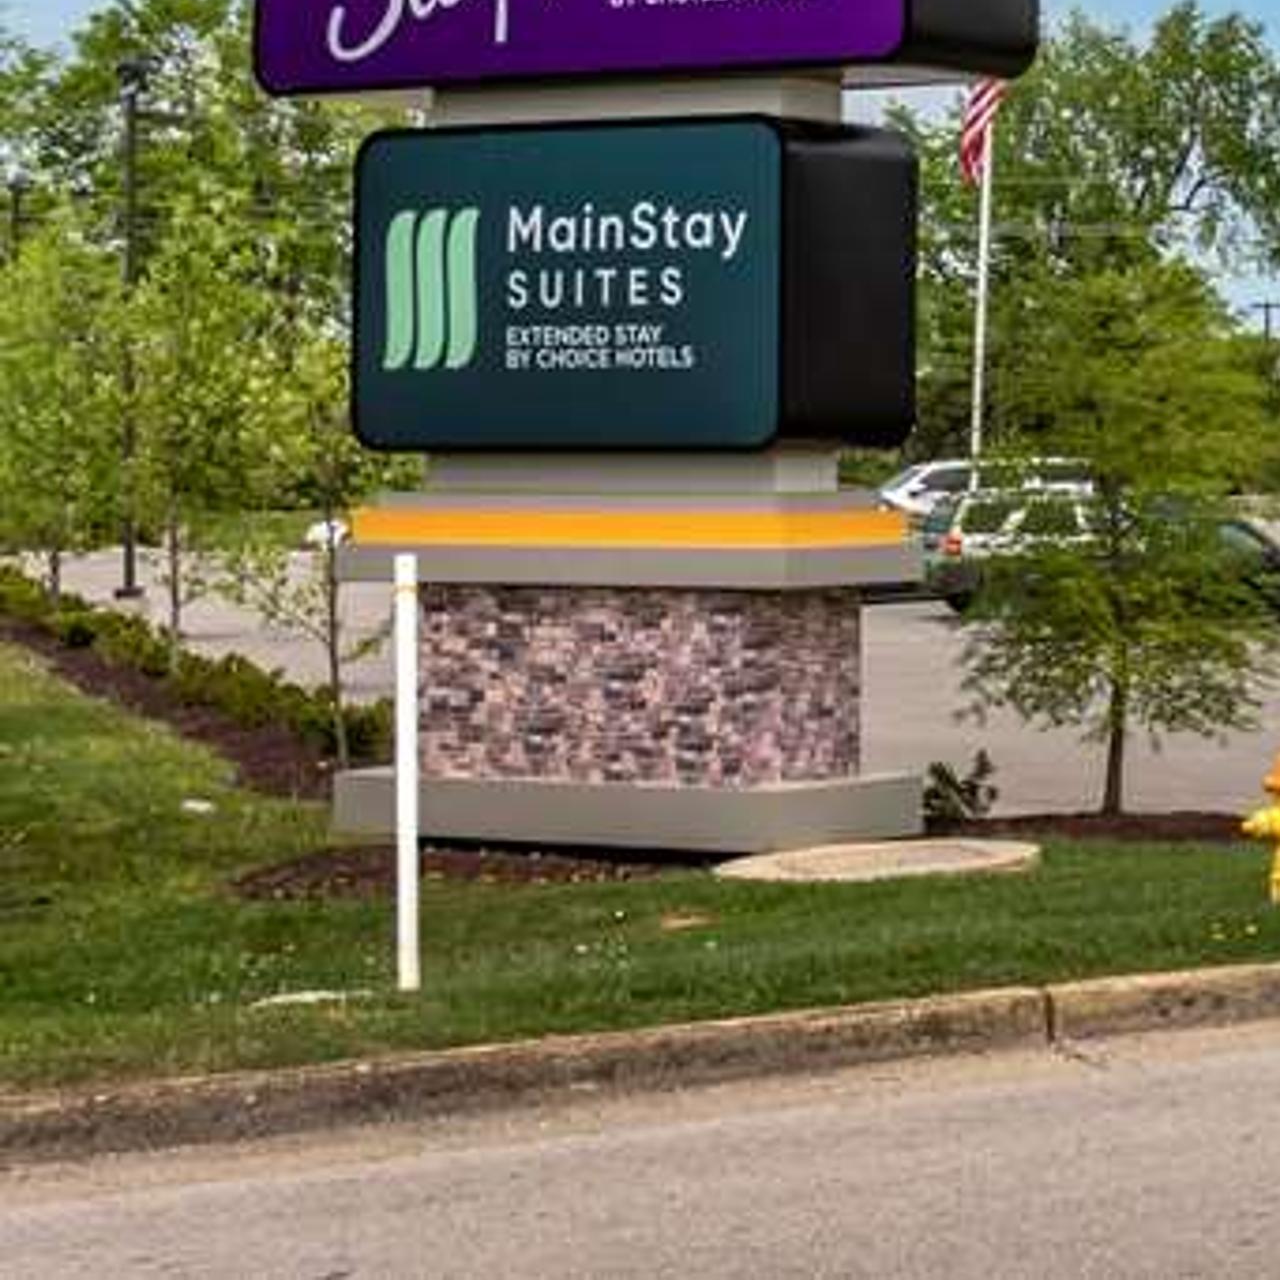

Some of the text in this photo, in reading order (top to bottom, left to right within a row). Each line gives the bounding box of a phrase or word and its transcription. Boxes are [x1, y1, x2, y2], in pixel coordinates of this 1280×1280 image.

[507, 201, 748, 259] MainStay
[508, 267, 683, 308] SUITES
[506, 324, 662, 346] EXTENDED STAY
[506, 345, 693, 368] BY CHOICE HOTELS
